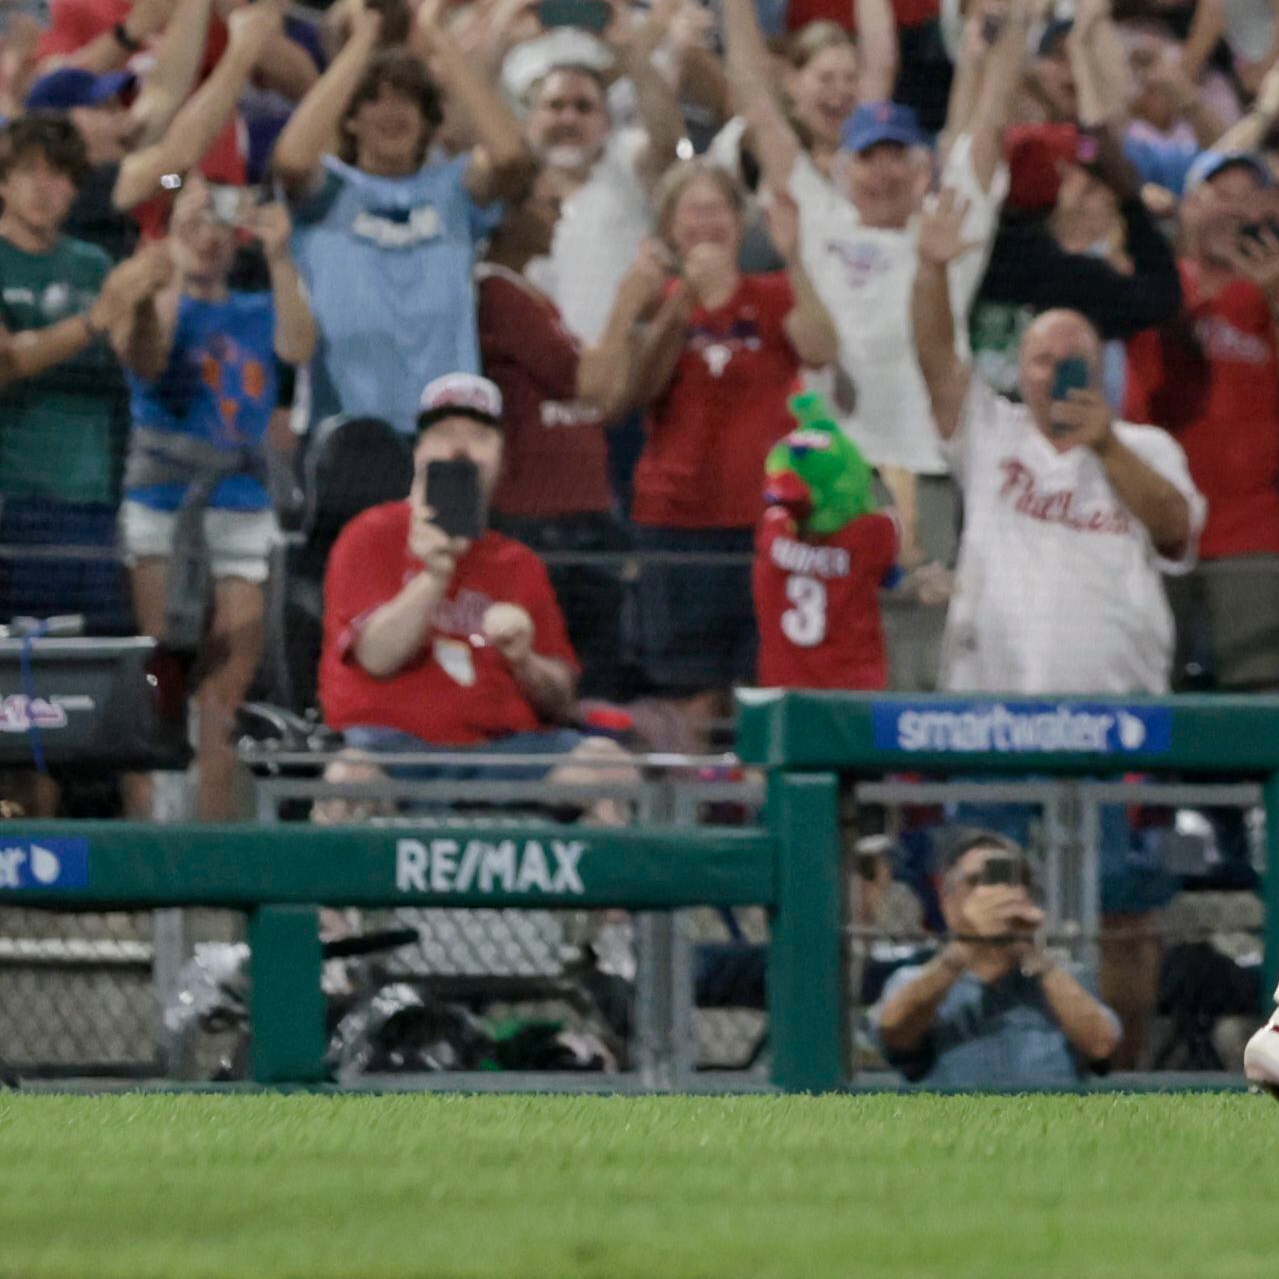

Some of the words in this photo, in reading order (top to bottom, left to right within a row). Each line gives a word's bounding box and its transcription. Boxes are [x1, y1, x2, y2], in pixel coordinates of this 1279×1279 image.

[781, 574, 828, 648] 3
[897, 703, 1116, 752] smartwater
[395, 838, 586, 894] RE/MAX
